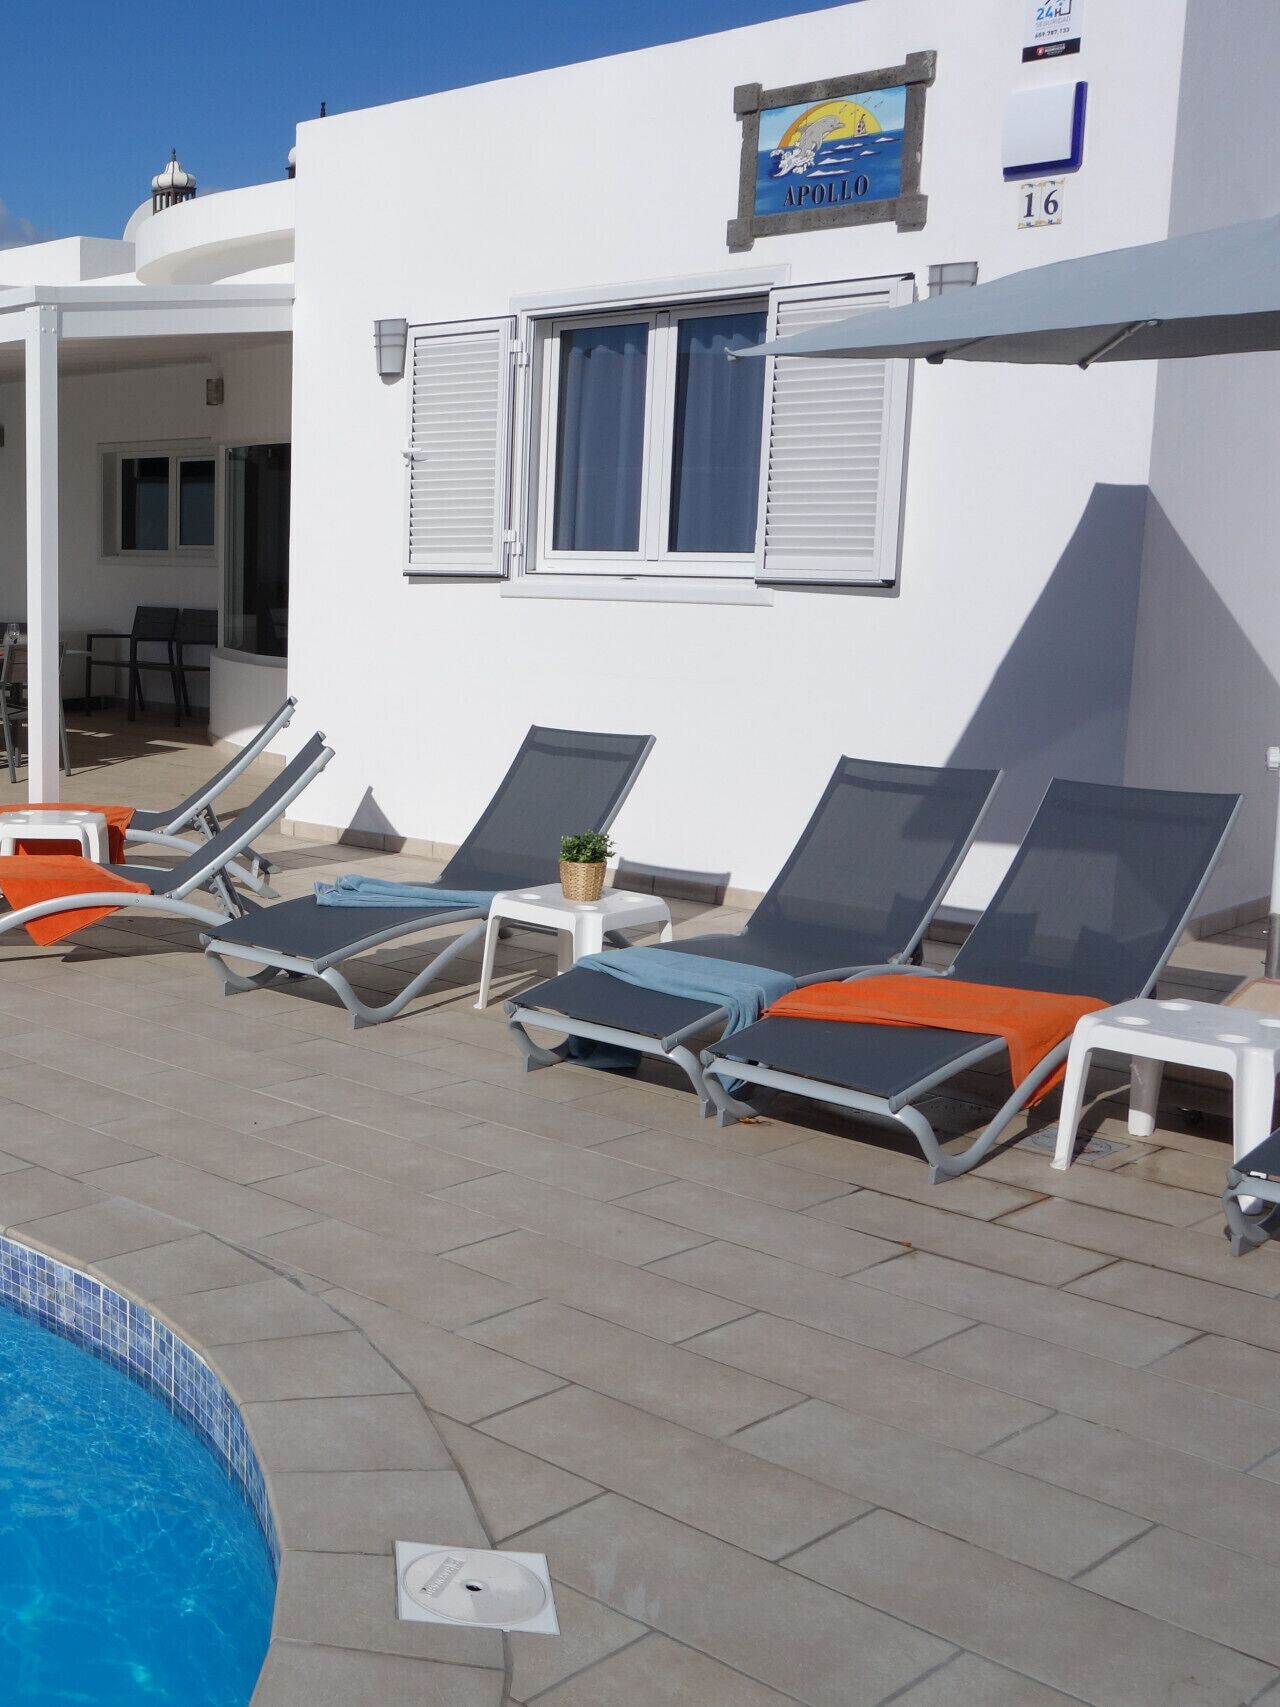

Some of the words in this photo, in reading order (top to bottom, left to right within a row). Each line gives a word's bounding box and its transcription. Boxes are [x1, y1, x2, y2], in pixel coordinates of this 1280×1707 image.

[1036, 6, 1062, 20] 24H
[784, 175, 870, 206] APOLLO
[1023, 189, 1059, 218] 16
